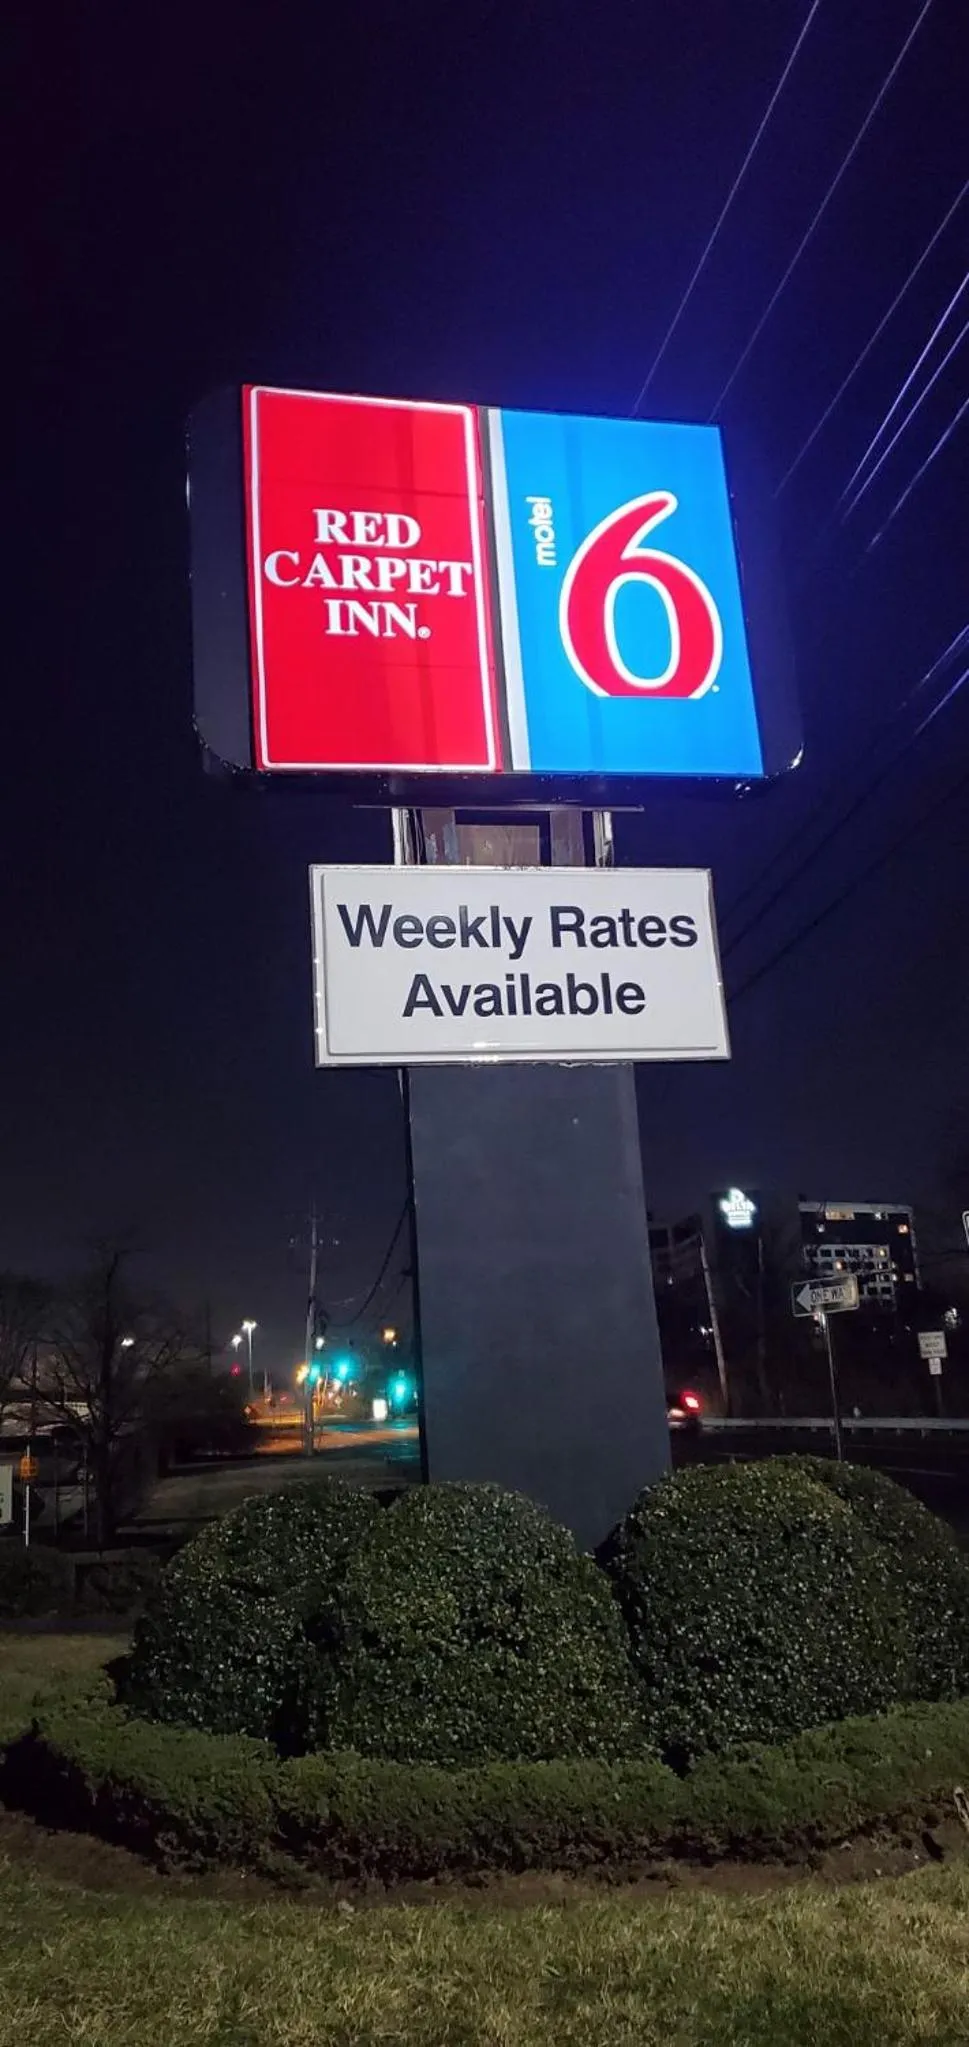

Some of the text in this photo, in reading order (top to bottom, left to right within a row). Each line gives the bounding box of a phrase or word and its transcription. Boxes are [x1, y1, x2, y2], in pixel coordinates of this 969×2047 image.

[314, 509, 421, 548] RED
[526, 496, 557, 567] motel
[264, 551, 472, 596] CARPET
[559, 491, 723, 698] 6
[336, 904, 698, 960] Weekly Rates
[402, 973, 646, 1017] Available
[811, 1288, 830, 1303] ONE
